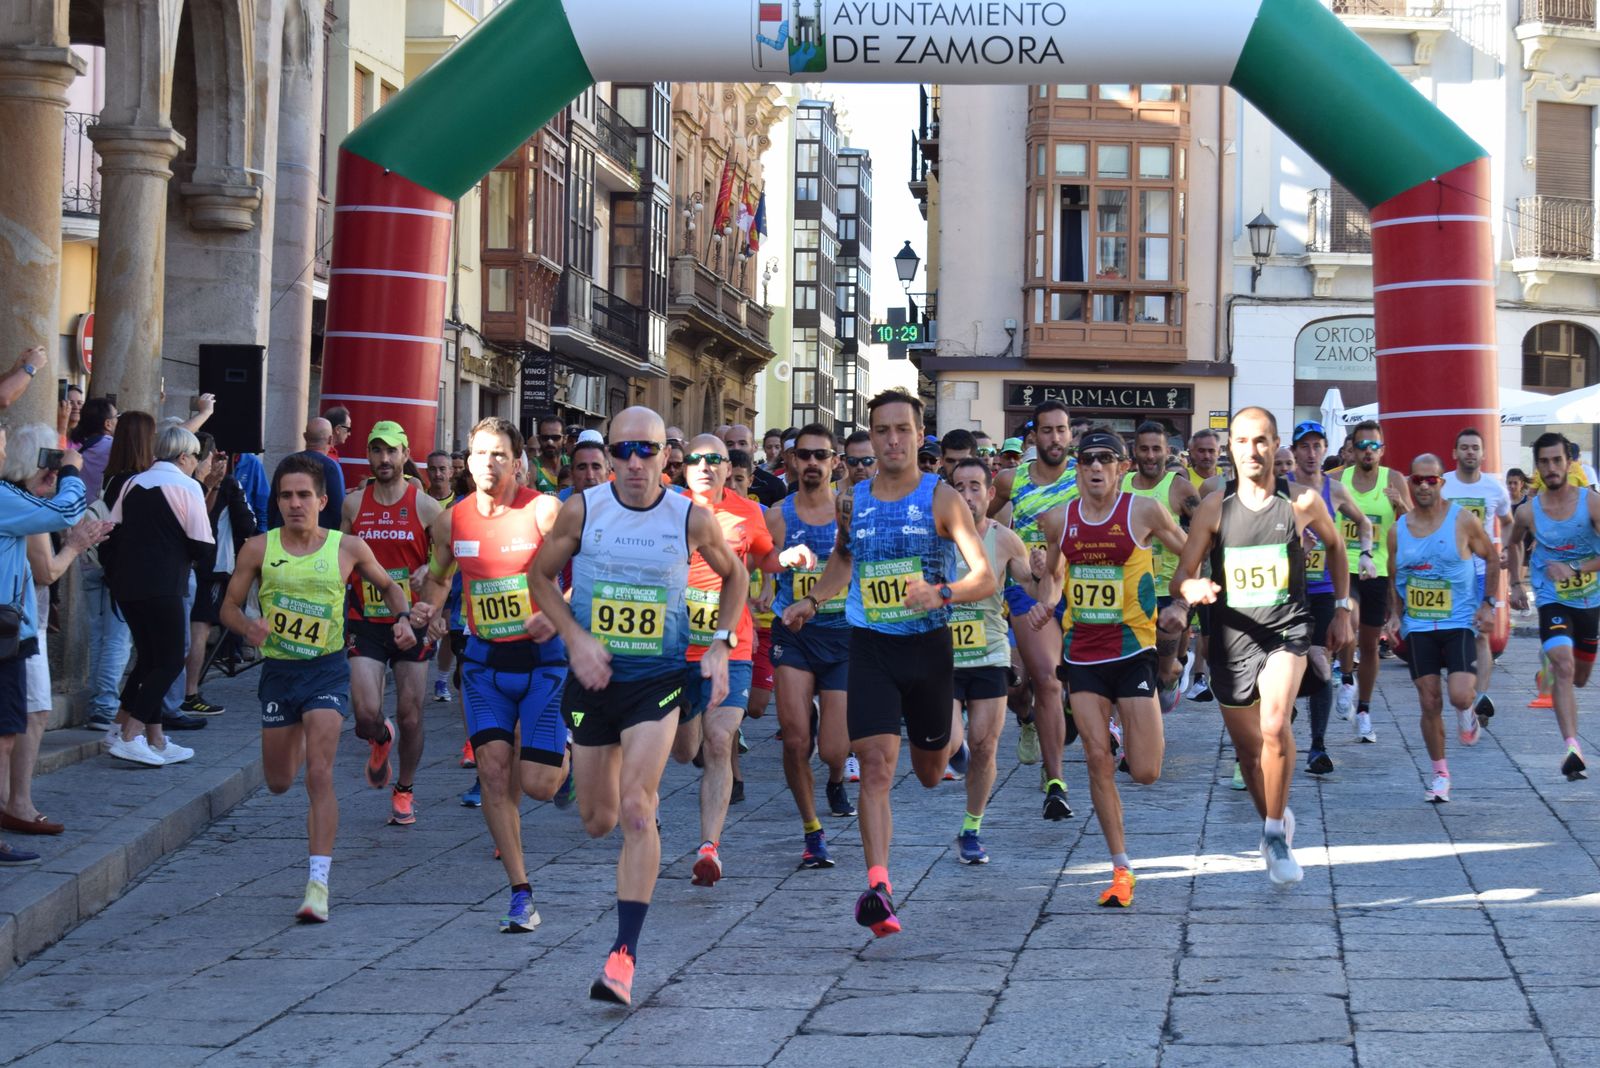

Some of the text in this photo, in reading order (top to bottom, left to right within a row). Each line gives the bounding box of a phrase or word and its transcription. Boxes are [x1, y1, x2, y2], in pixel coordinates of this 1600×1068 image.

[833, 2, 1066, 26] AYUNTAMIENTO
[833, 35, 1065, 65] DE ZAMORA
[877, 325, 918, 342] 10:29
[1314, 326, 1375, 343] ORTOP
[1314, 345, 1376, 362] ZAMOR
[1044, 388, 1156, 407] FARMACIA
[358, 528, 415, 541] CÁRCOBA
[614, 537, 655, 547] ALTITUD
[1082, 552, 1106, 560] VINO
[1233, 564, 1277, 590] 951
[615, 586, 657, 596] FUNDACION
[1073, 583, 1116, 607] 979
[1409, 589, 1446, 607] 1024
[477, 595, 521, 621] 1015
[881, 611, 898, 619] CAJA
[1081, 611, 1096, 619] CAJA
[274, 612, 320, 644] 944
[598, 605, 656, 635] 938
[490, 626, 507, 635] CAJA
[280, 640, 296, 652] CAJA
[610, 640, 658, 650] CAJA RURAL
